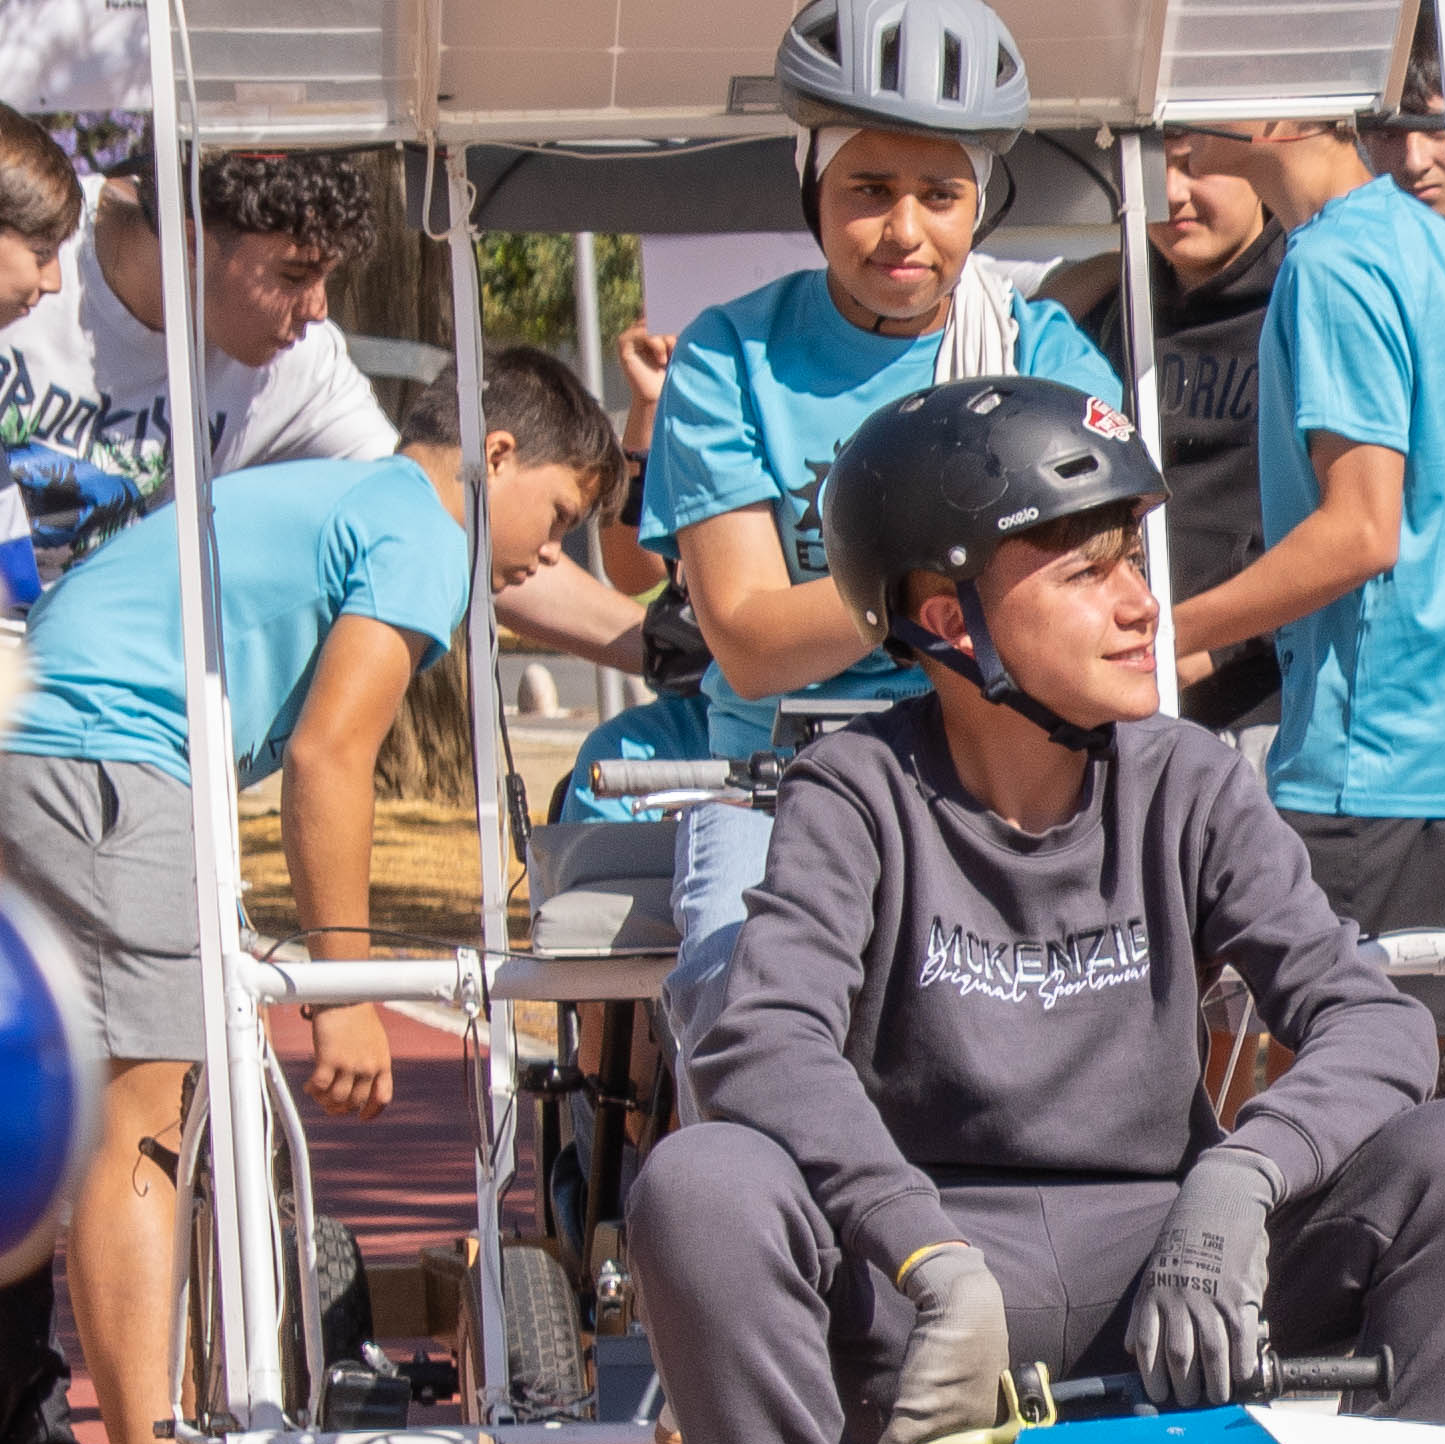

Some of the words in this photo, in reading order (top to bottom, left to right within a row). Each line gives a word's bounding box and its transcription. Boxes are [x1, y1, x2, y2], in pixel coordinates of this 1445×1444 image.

[998, 506, 1040, 530] oxelo
[920, 951, 1027, 1003] Original
[1038, 962, 1150, 1011] Sportswear
[1149, 1270, 1218, 1298] ISSALINE
